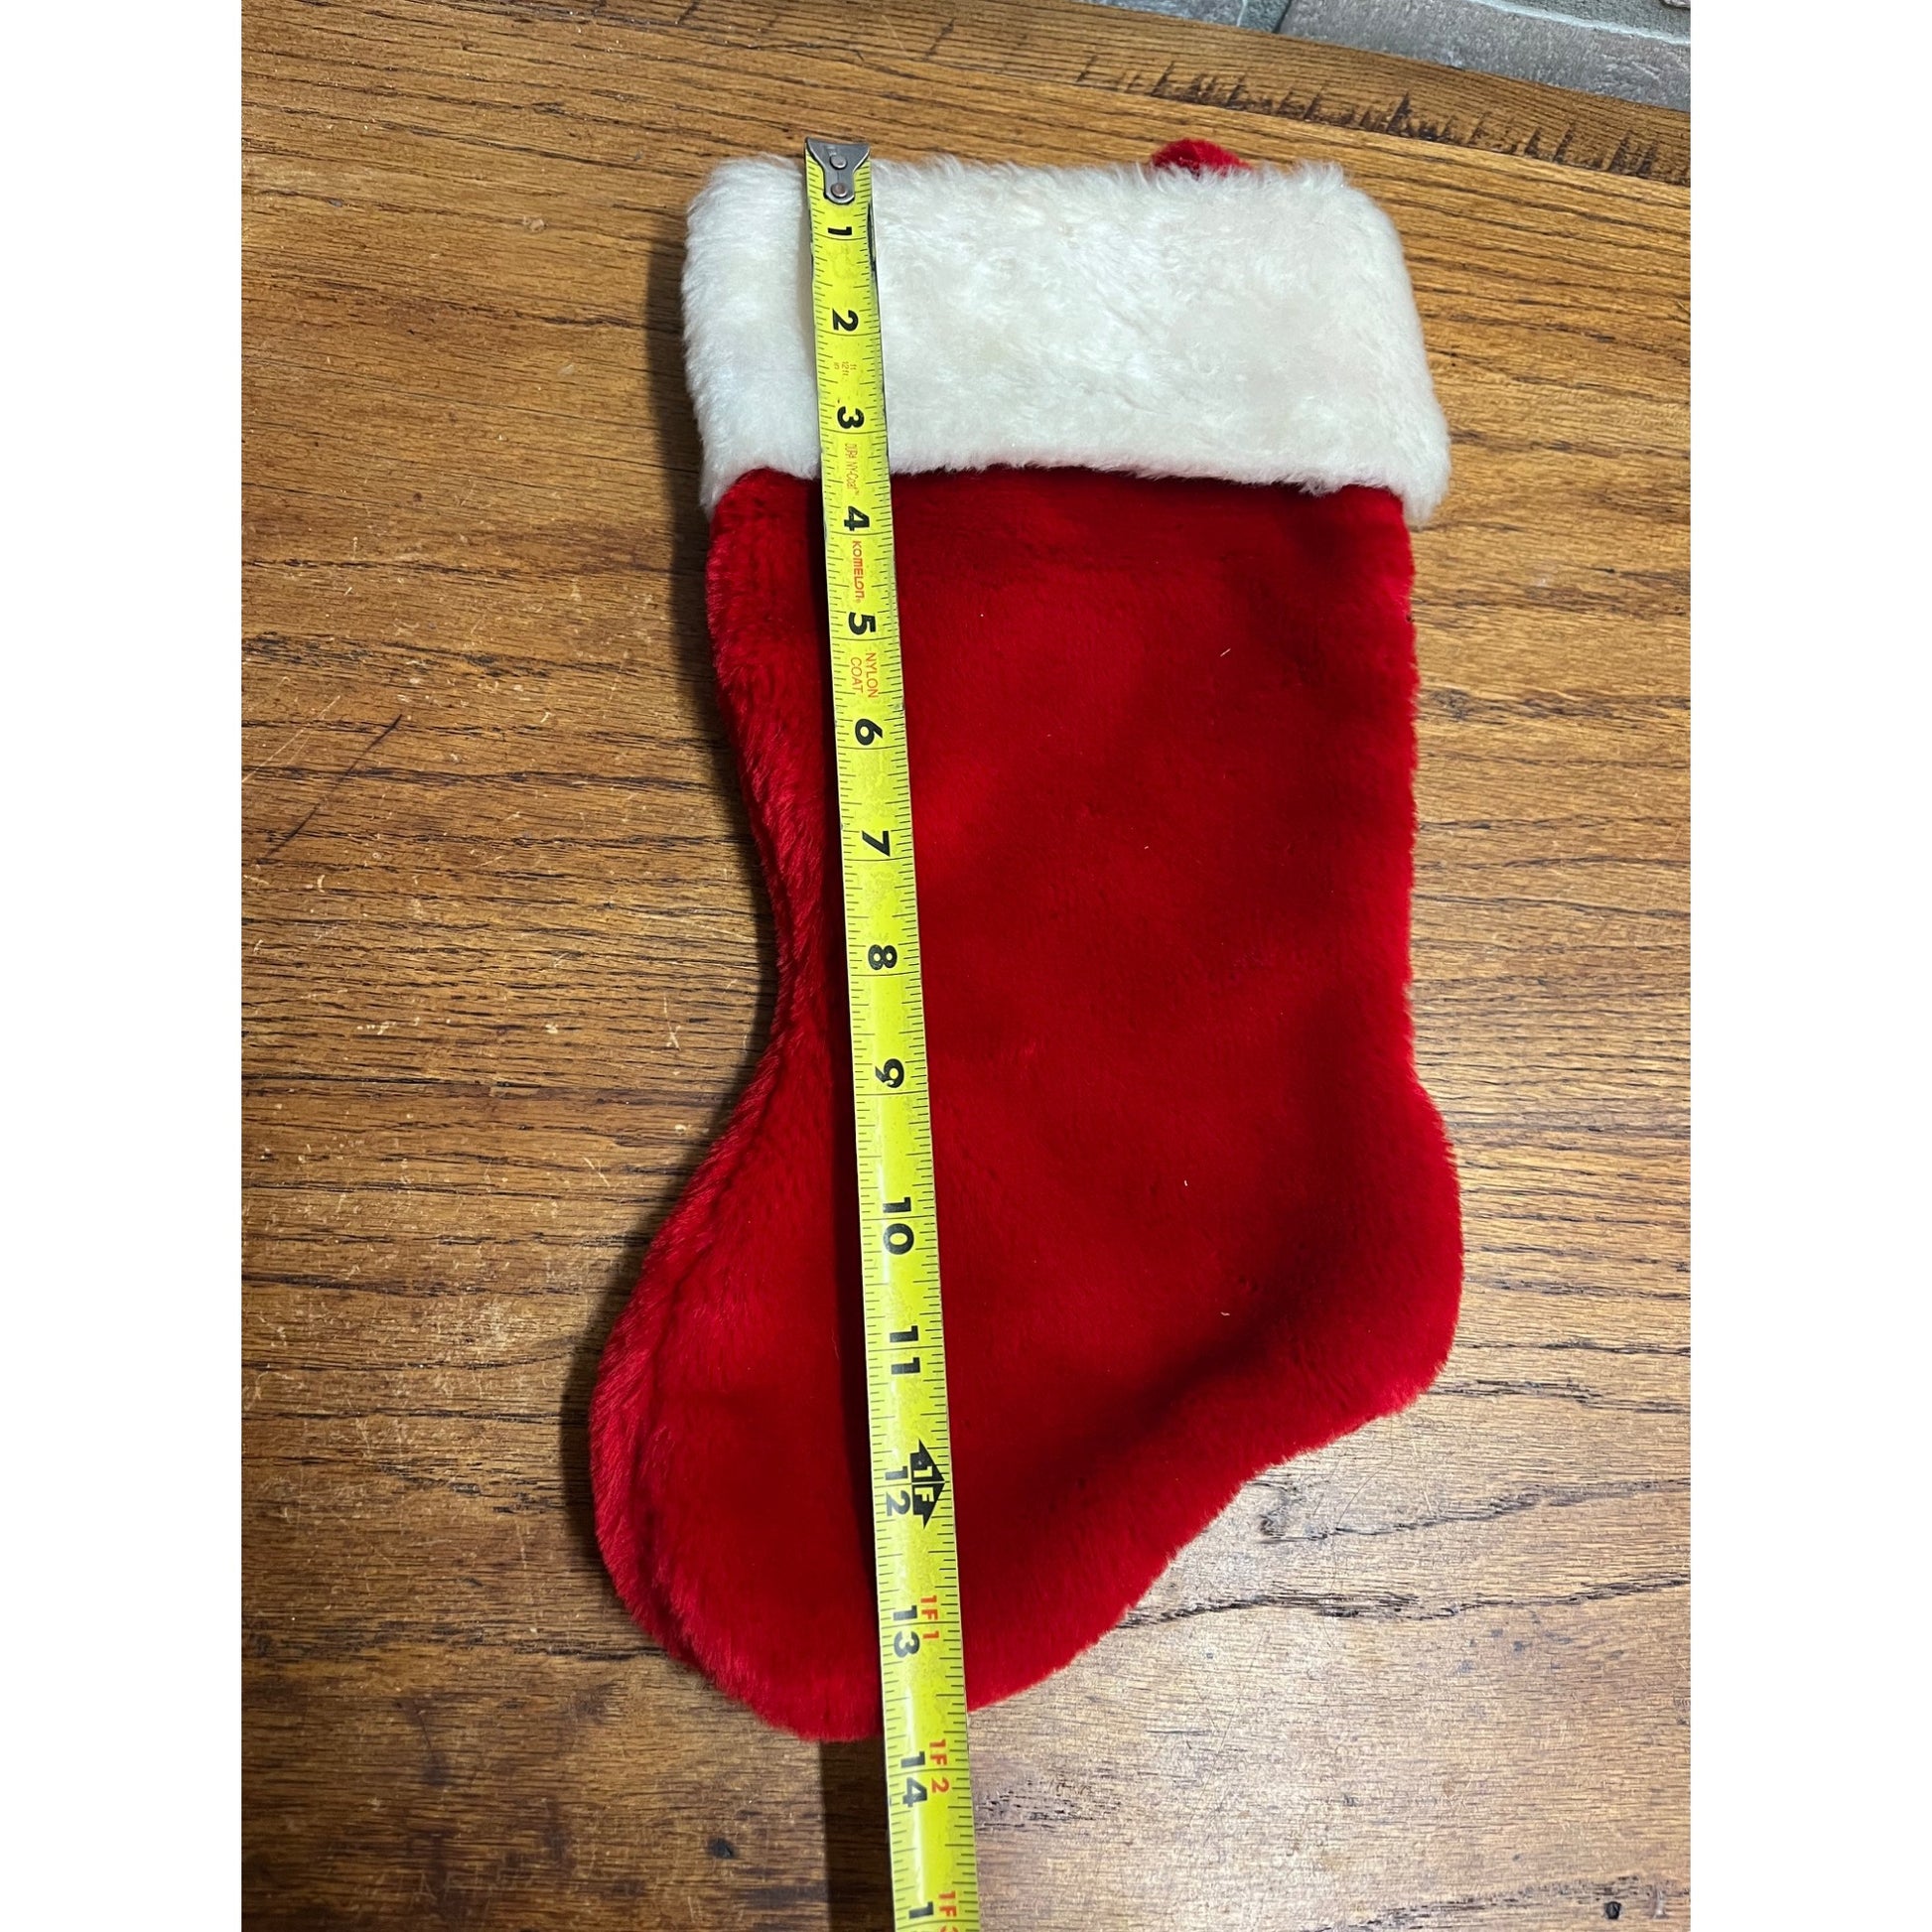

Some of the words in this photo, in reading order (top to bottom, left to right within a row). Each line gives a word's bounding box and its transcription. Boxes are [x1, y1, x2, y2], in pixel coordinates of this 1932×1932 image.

[828, 226, 852, 236] 1
[832, 309, 859, 332] 2
[837, 406, 865, 429] 3
[844, 506, 870, 531] 4
[848, 612, 876, 635] 5
[850, 657, 864, 693] COAT
[866, 652, 879, 698] NYLON
[855, 719, 884, 746] 6
[862, 830, 891, 857] 7
[868, 944, 897, 970] 8
[875, 1058, 904, 1088] 9
[883, 1197, 914, 1255] 10
[890, 1325, 920, 1374] 11
[886, 1465, 911, 1517] 12
[894, 1604, 919, 1658] 13
[901, 1751, 927, 1807] 14
